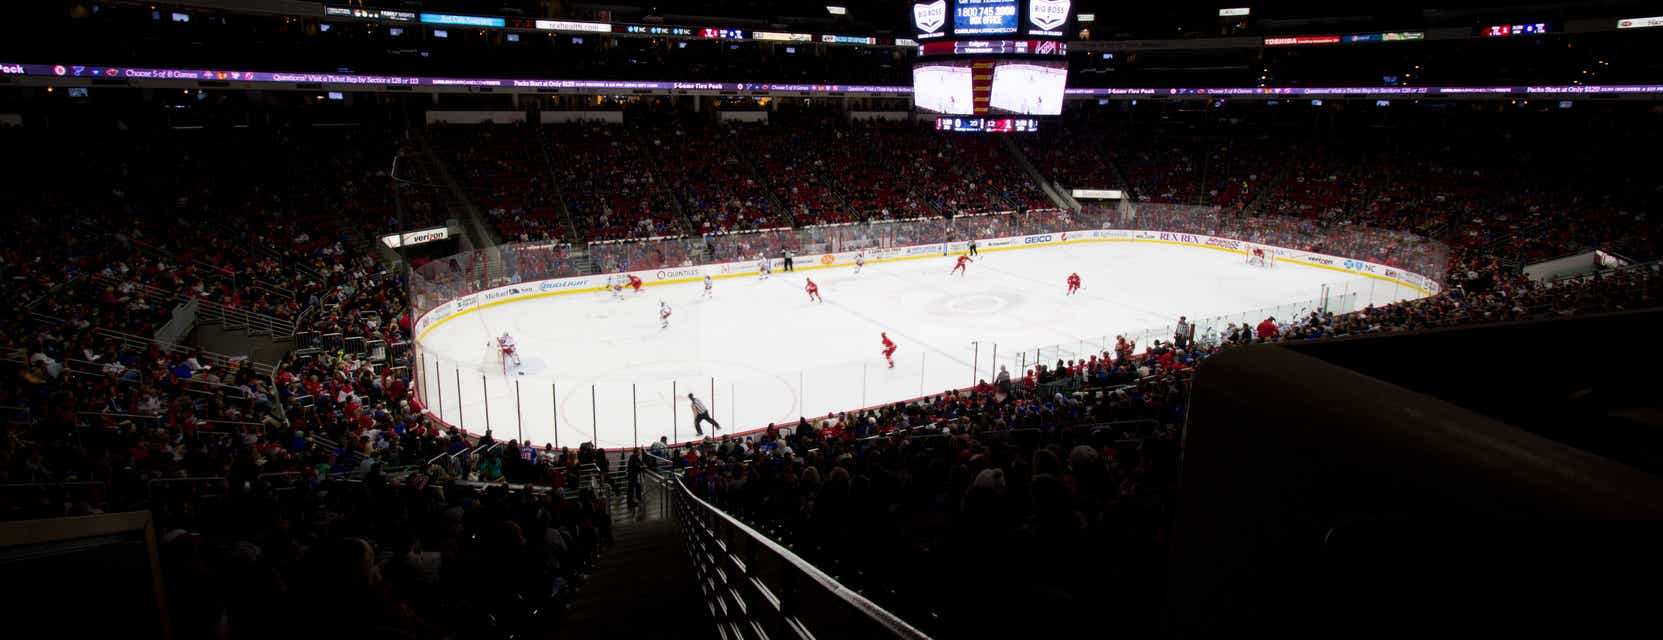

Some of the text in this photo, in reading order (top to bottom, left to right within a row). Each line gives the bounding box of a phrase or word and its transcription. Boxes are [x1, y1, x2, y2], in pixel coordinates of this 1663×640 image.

[963, 8, 978, 16] 800
[979, 8, 994, 16] 745
[983, 16, 1002, 24] OFFICE
[414, 232, 443, 242] verizon
[1025, 235, 1052, 244] GEICO
[1160, 233, 1179, 242] REX
[1181, 233, 1200, 244] REX
[1364, 264, 1376, 273] NC
